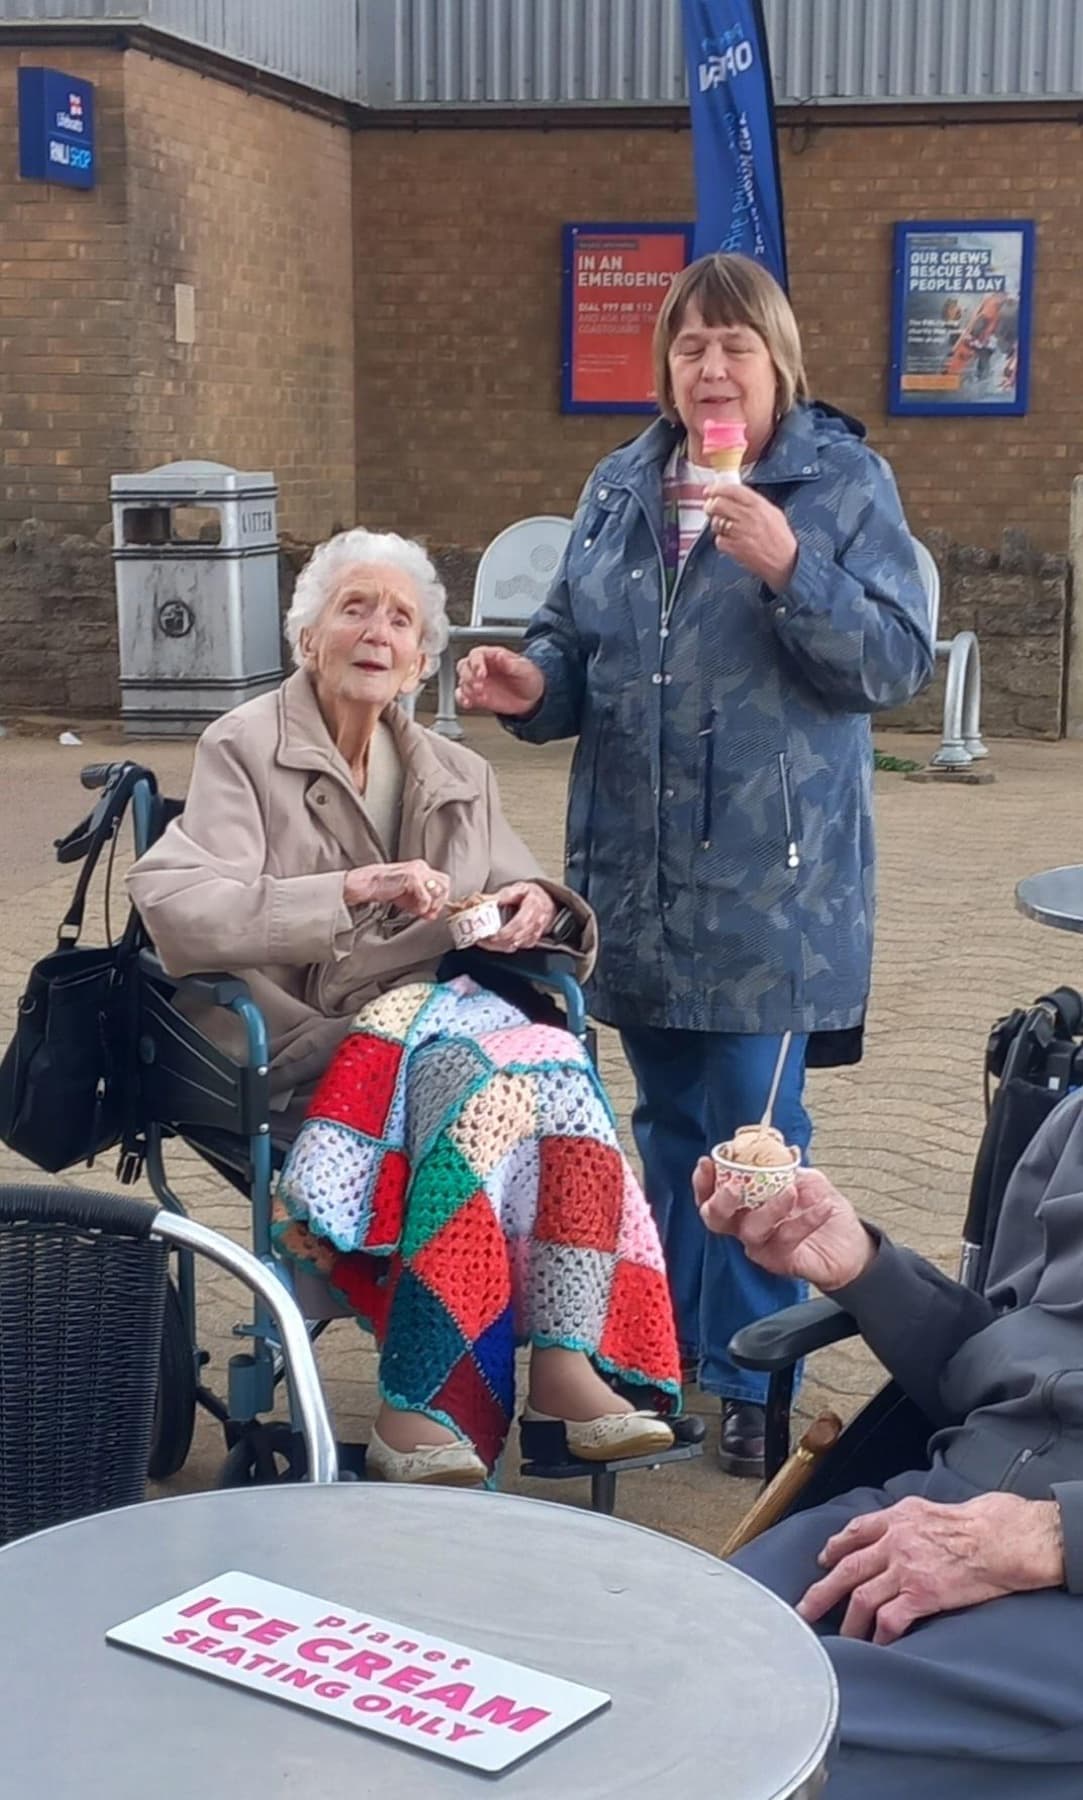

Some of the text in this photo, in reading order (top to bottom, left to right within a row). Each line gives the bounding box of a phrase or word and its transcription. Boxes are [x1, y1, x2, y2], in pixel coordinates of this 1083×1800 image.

[578, 255, 623, 270] IN AN
[910, 251, 989, 265] OUR CREWS
[910, 265, 964, 277] RESCUE
[578, 272, 677, 287] EMERGENCY
[910, 278, 1004, 291] PEOPLE A DAY
[578, 303, 600, 312] DIAL
[602, 303, 618, 312] 999
[313, 1615, 472, 1671] planet
[177, 1596, 552, 1733] ICE CREAM
[162, 1628, 485, 1742] SEATING ONLY
